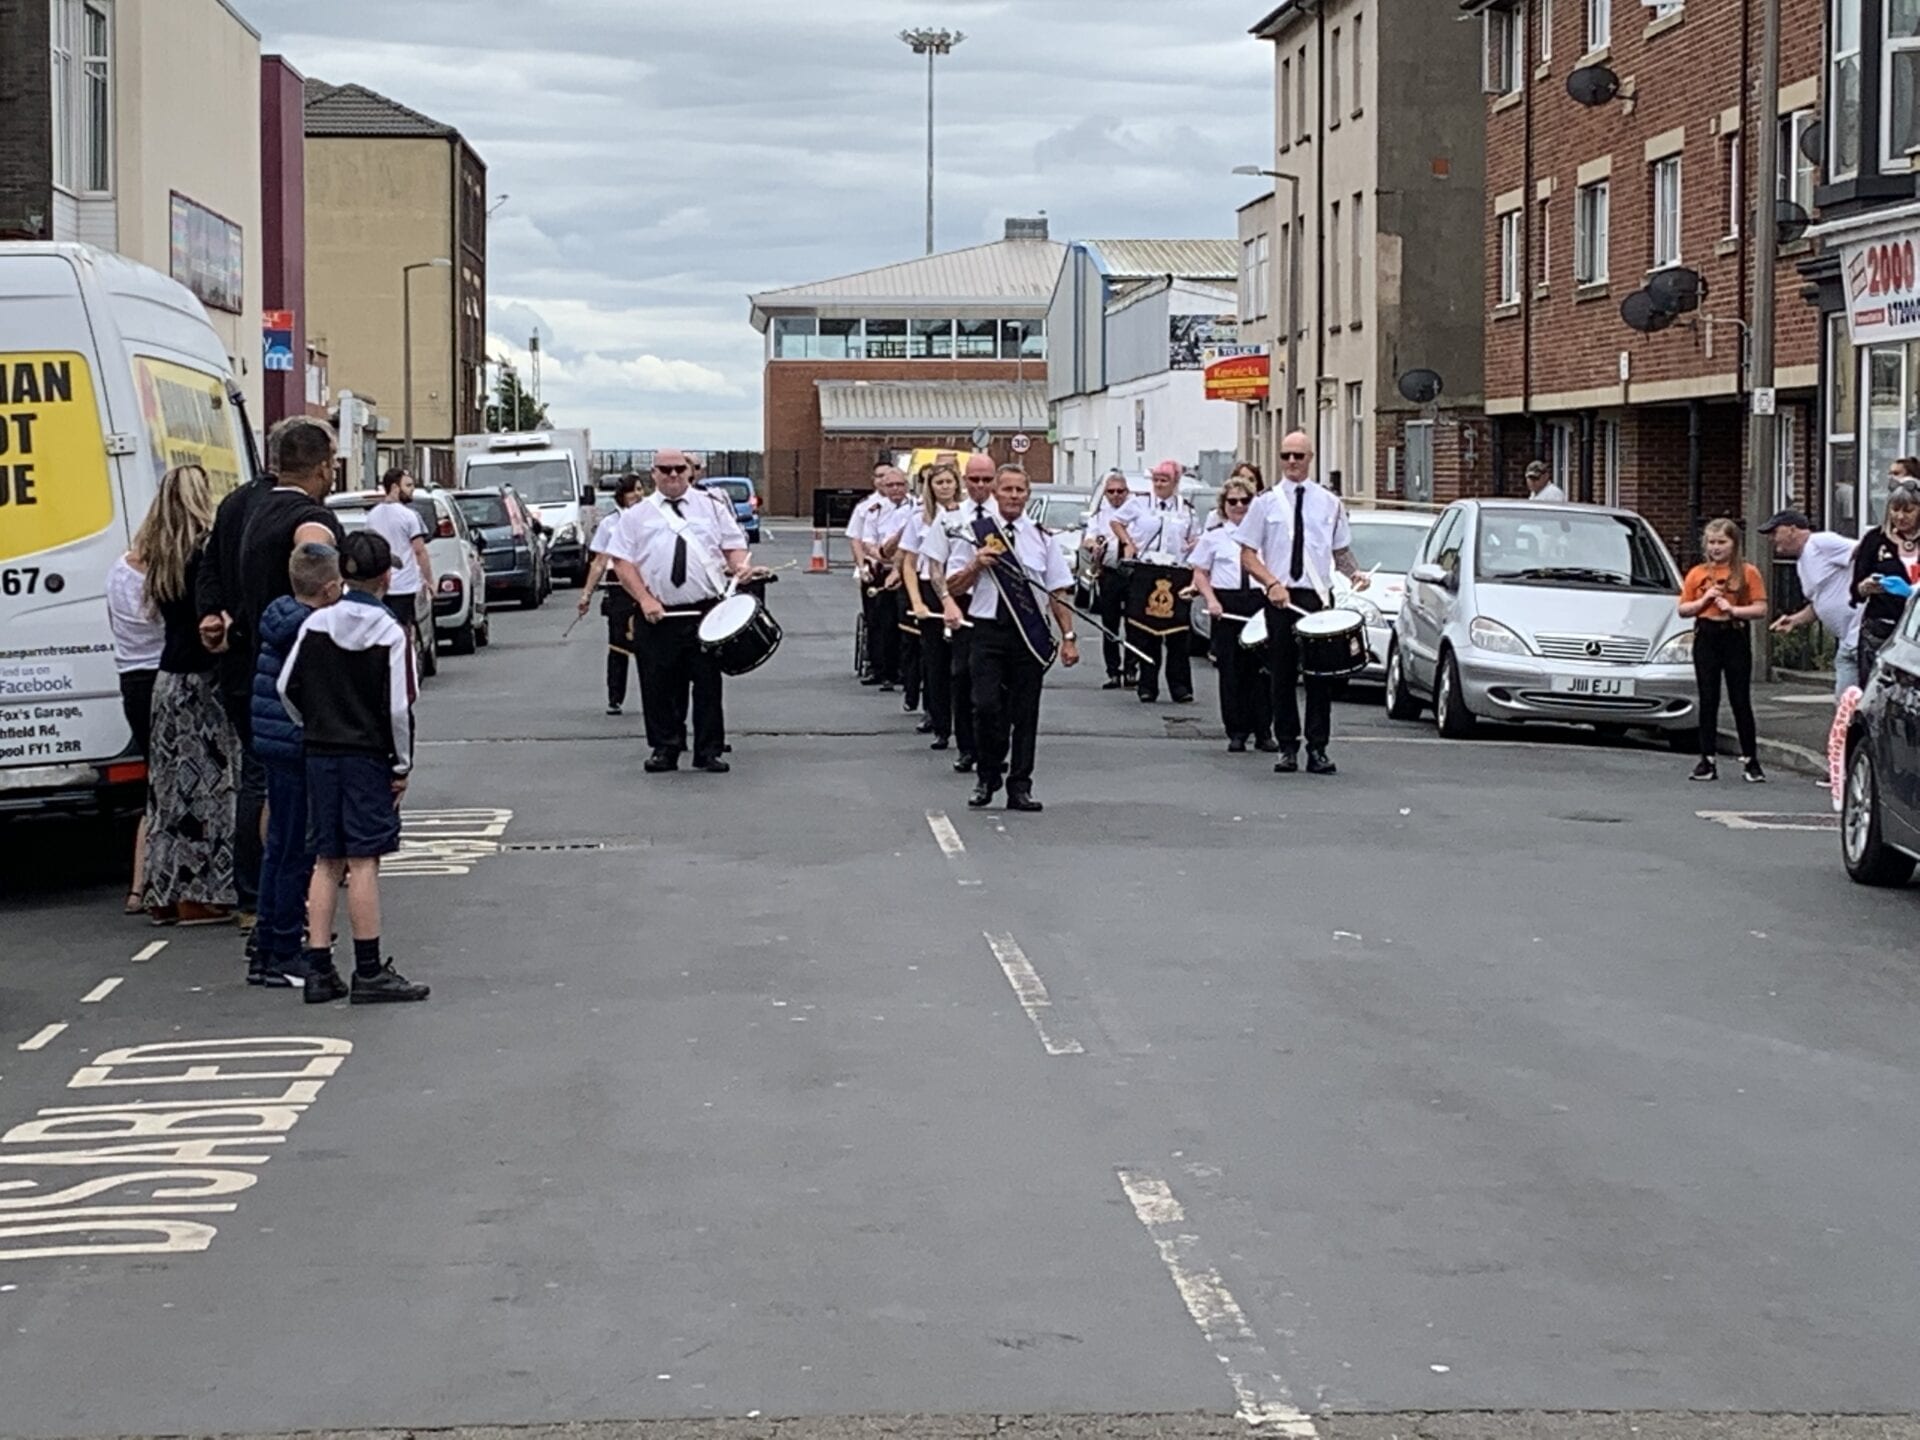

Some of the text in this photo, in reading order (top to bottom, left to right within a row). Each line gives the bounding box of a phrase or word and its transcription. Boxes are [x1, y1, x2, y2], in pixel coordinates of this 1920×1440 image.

[1867, 240, 1915, 297] 2000
[1014, 438, 1028, 449] 30
[22, 667, 34, 676] us
[36, 666, 50, 676] on
[0, 675, 73, 694] Facebook
[1592, 678, 1621, 694] EJJ
[34, 706, 83, 719] Garage,
[39, 723, 60, 738] Rd,
[28, 742, 51, 755] FY1
[56, 740, 82, 753] 2RR
